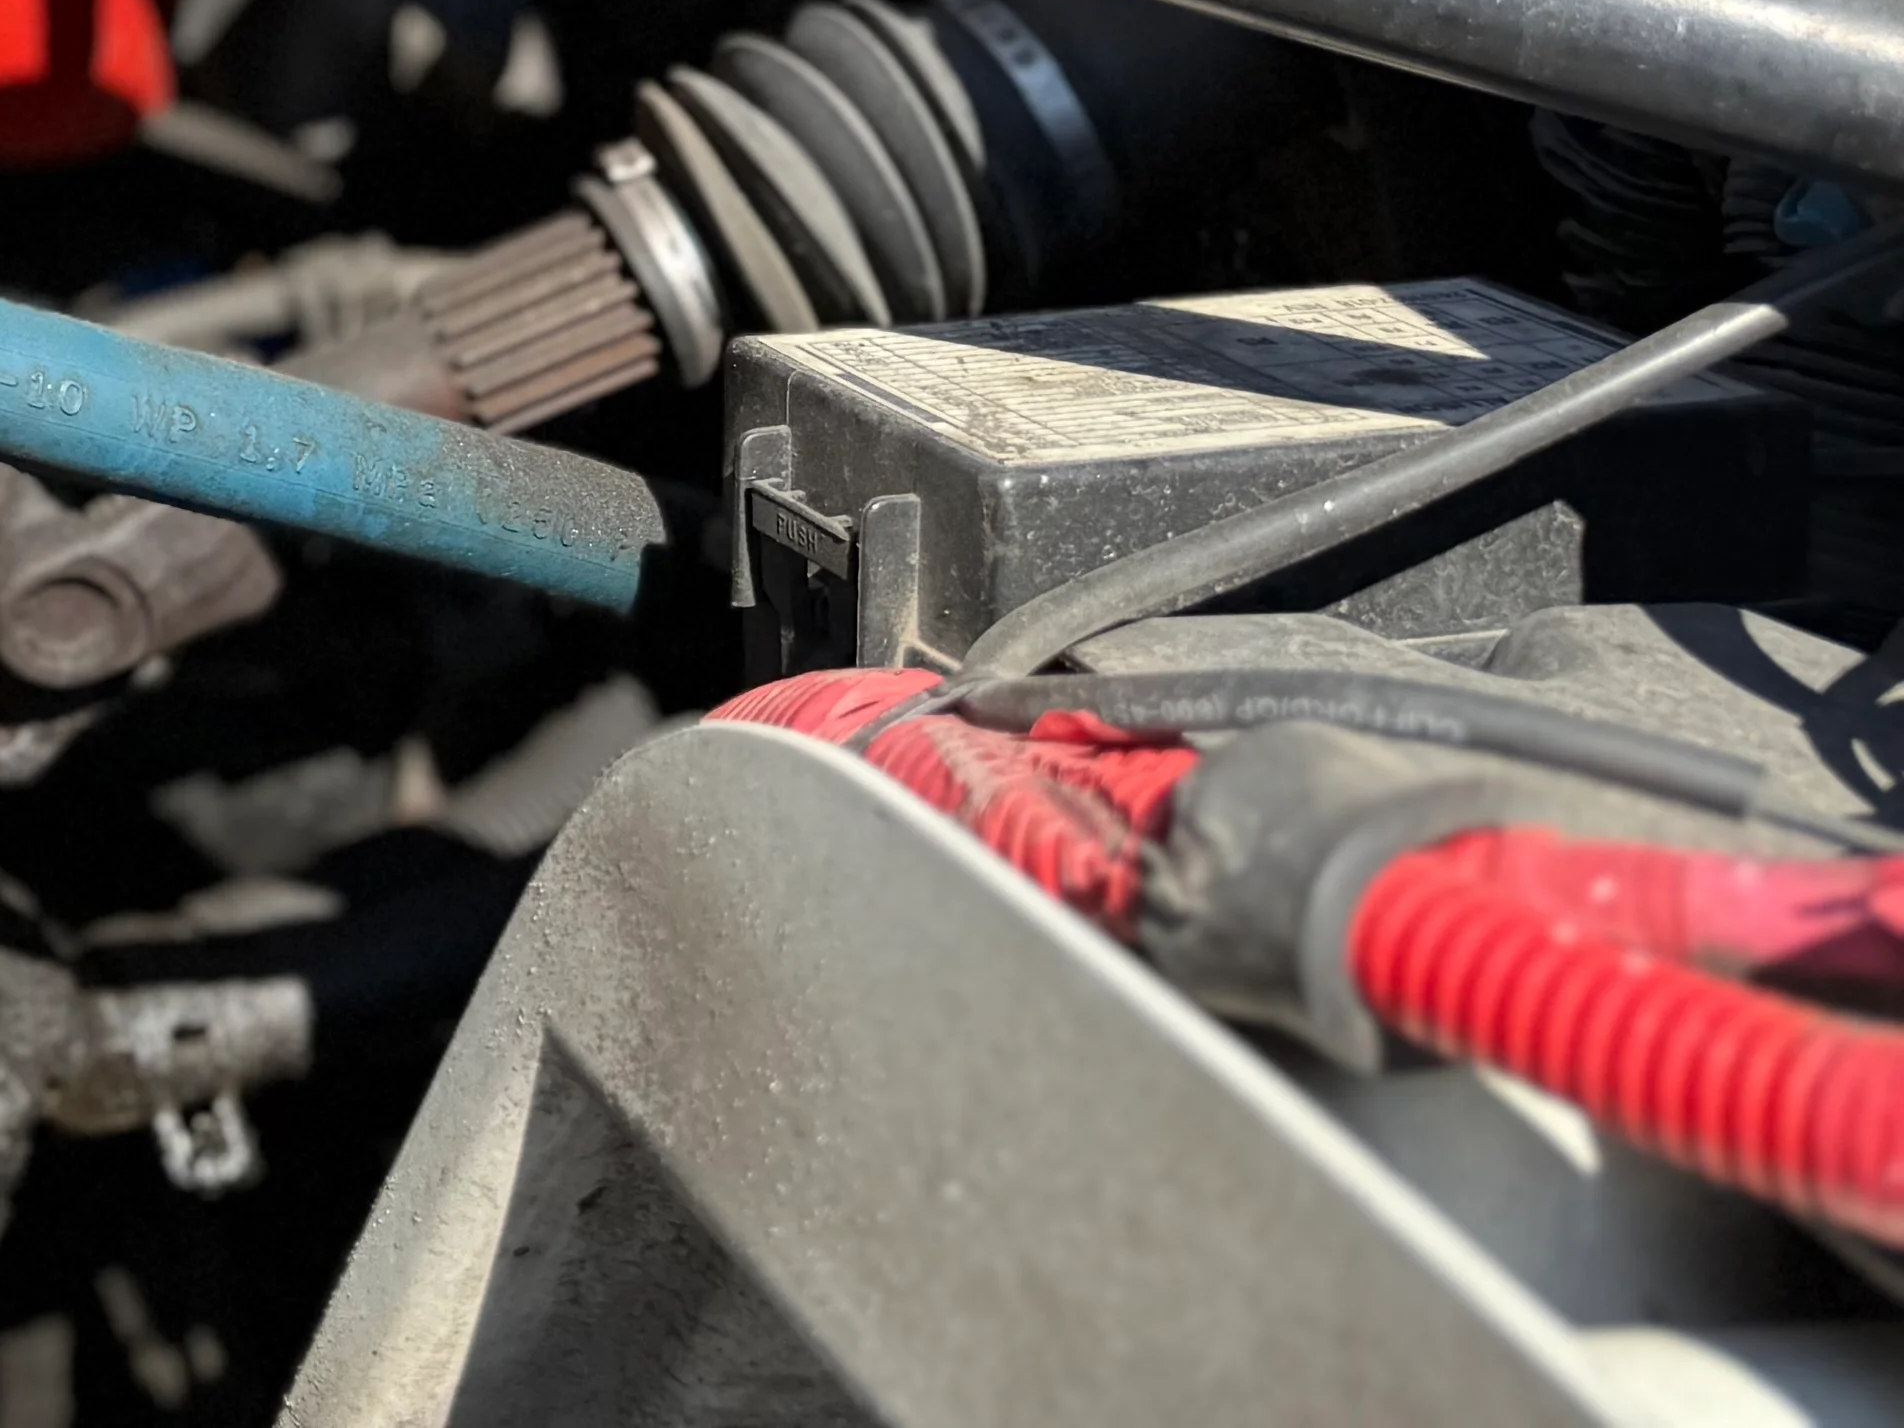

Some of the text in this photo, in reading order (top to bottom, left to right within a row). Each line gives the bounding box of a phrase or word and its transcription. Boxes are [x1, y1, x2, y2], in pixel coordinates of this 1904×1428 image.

[130, 390, 198, 444] WP
[238, 424, 318, 475] 1.7
[775, 512, 819, 555] PUSH
